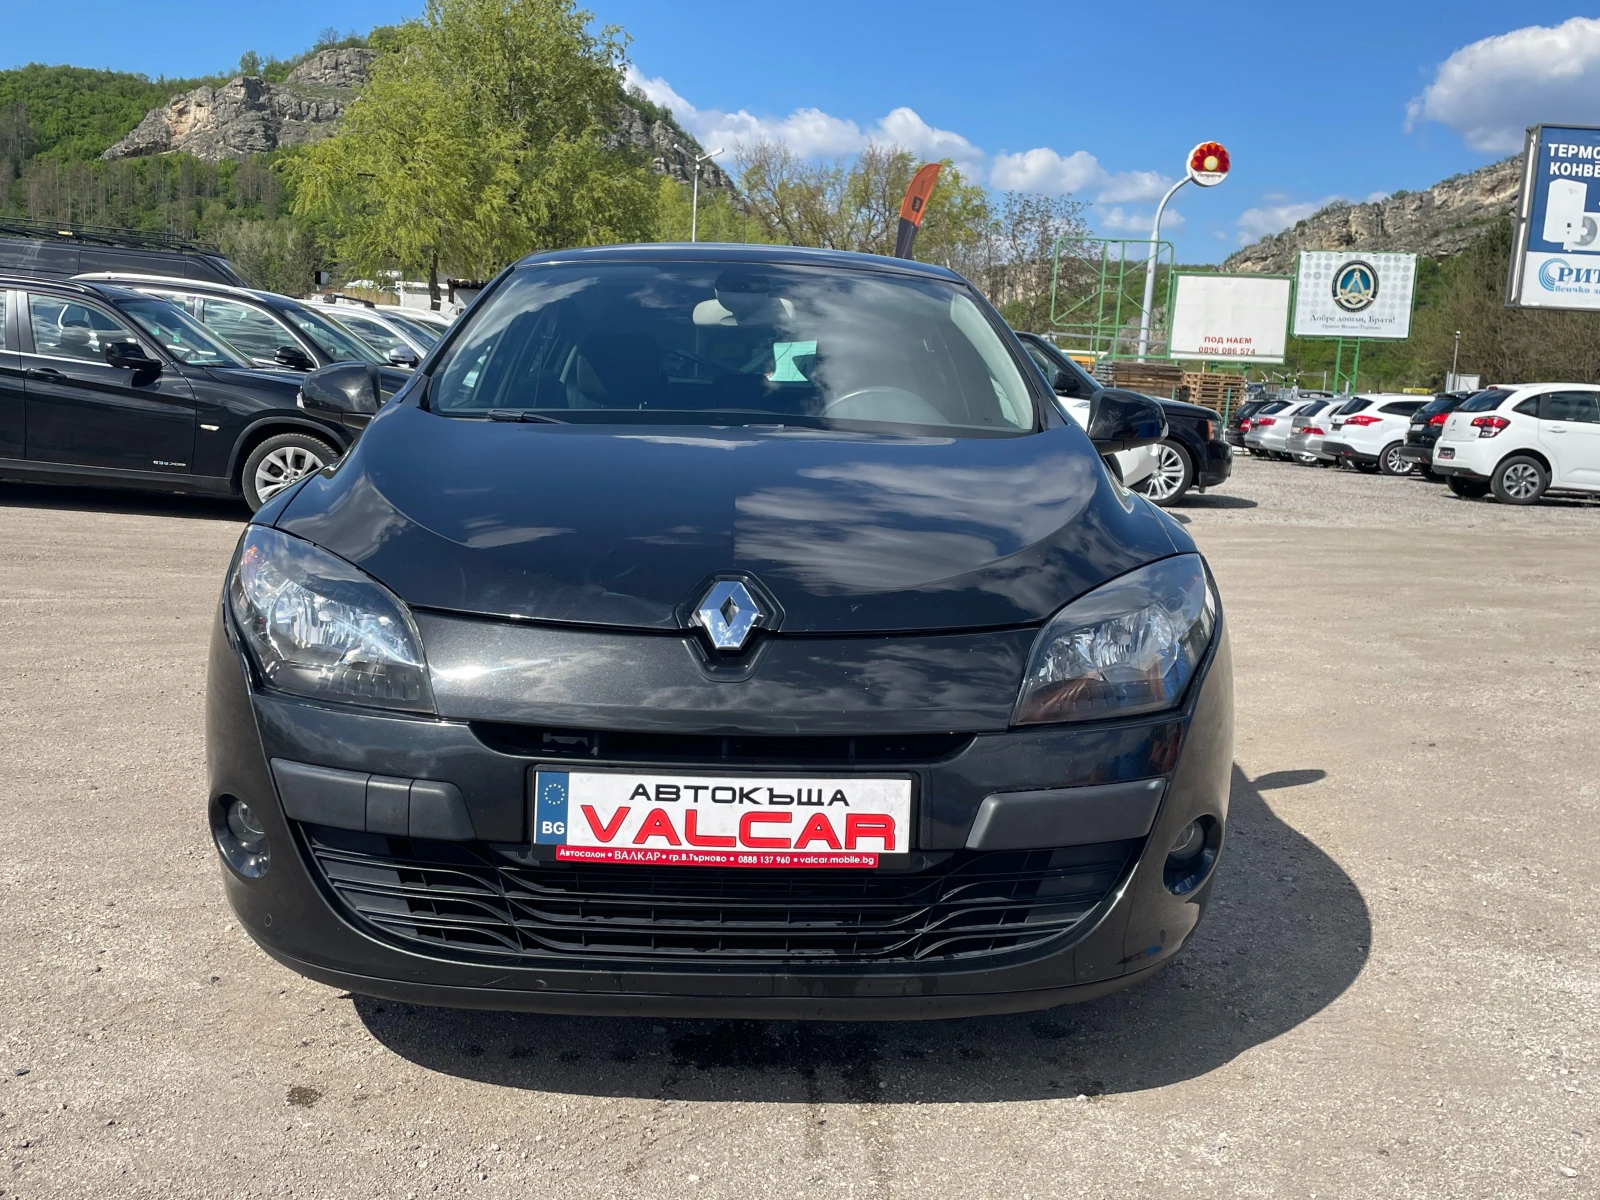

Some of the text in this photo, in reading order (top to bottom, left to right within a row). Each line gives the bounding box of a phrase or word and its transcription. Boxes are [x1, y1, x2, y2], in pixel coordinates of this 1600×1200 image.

[1204, 336, 1224, 344] ПОД
[1199, 346, 1256, 356] 0896 086 574
[542, 821, 565, 835] BG
[581, 805, 896, 851] VALCAR
[559, 849, 605, 859] Автосалон
[614, 851, 661, 861] ВАЛКАР
[738, 856, 758, 864] 0888
[760, 856, 774, 864] 137
[776, 857, 790, 865] 960
[800, 856, 875, 866] valcar.mobile.bg
